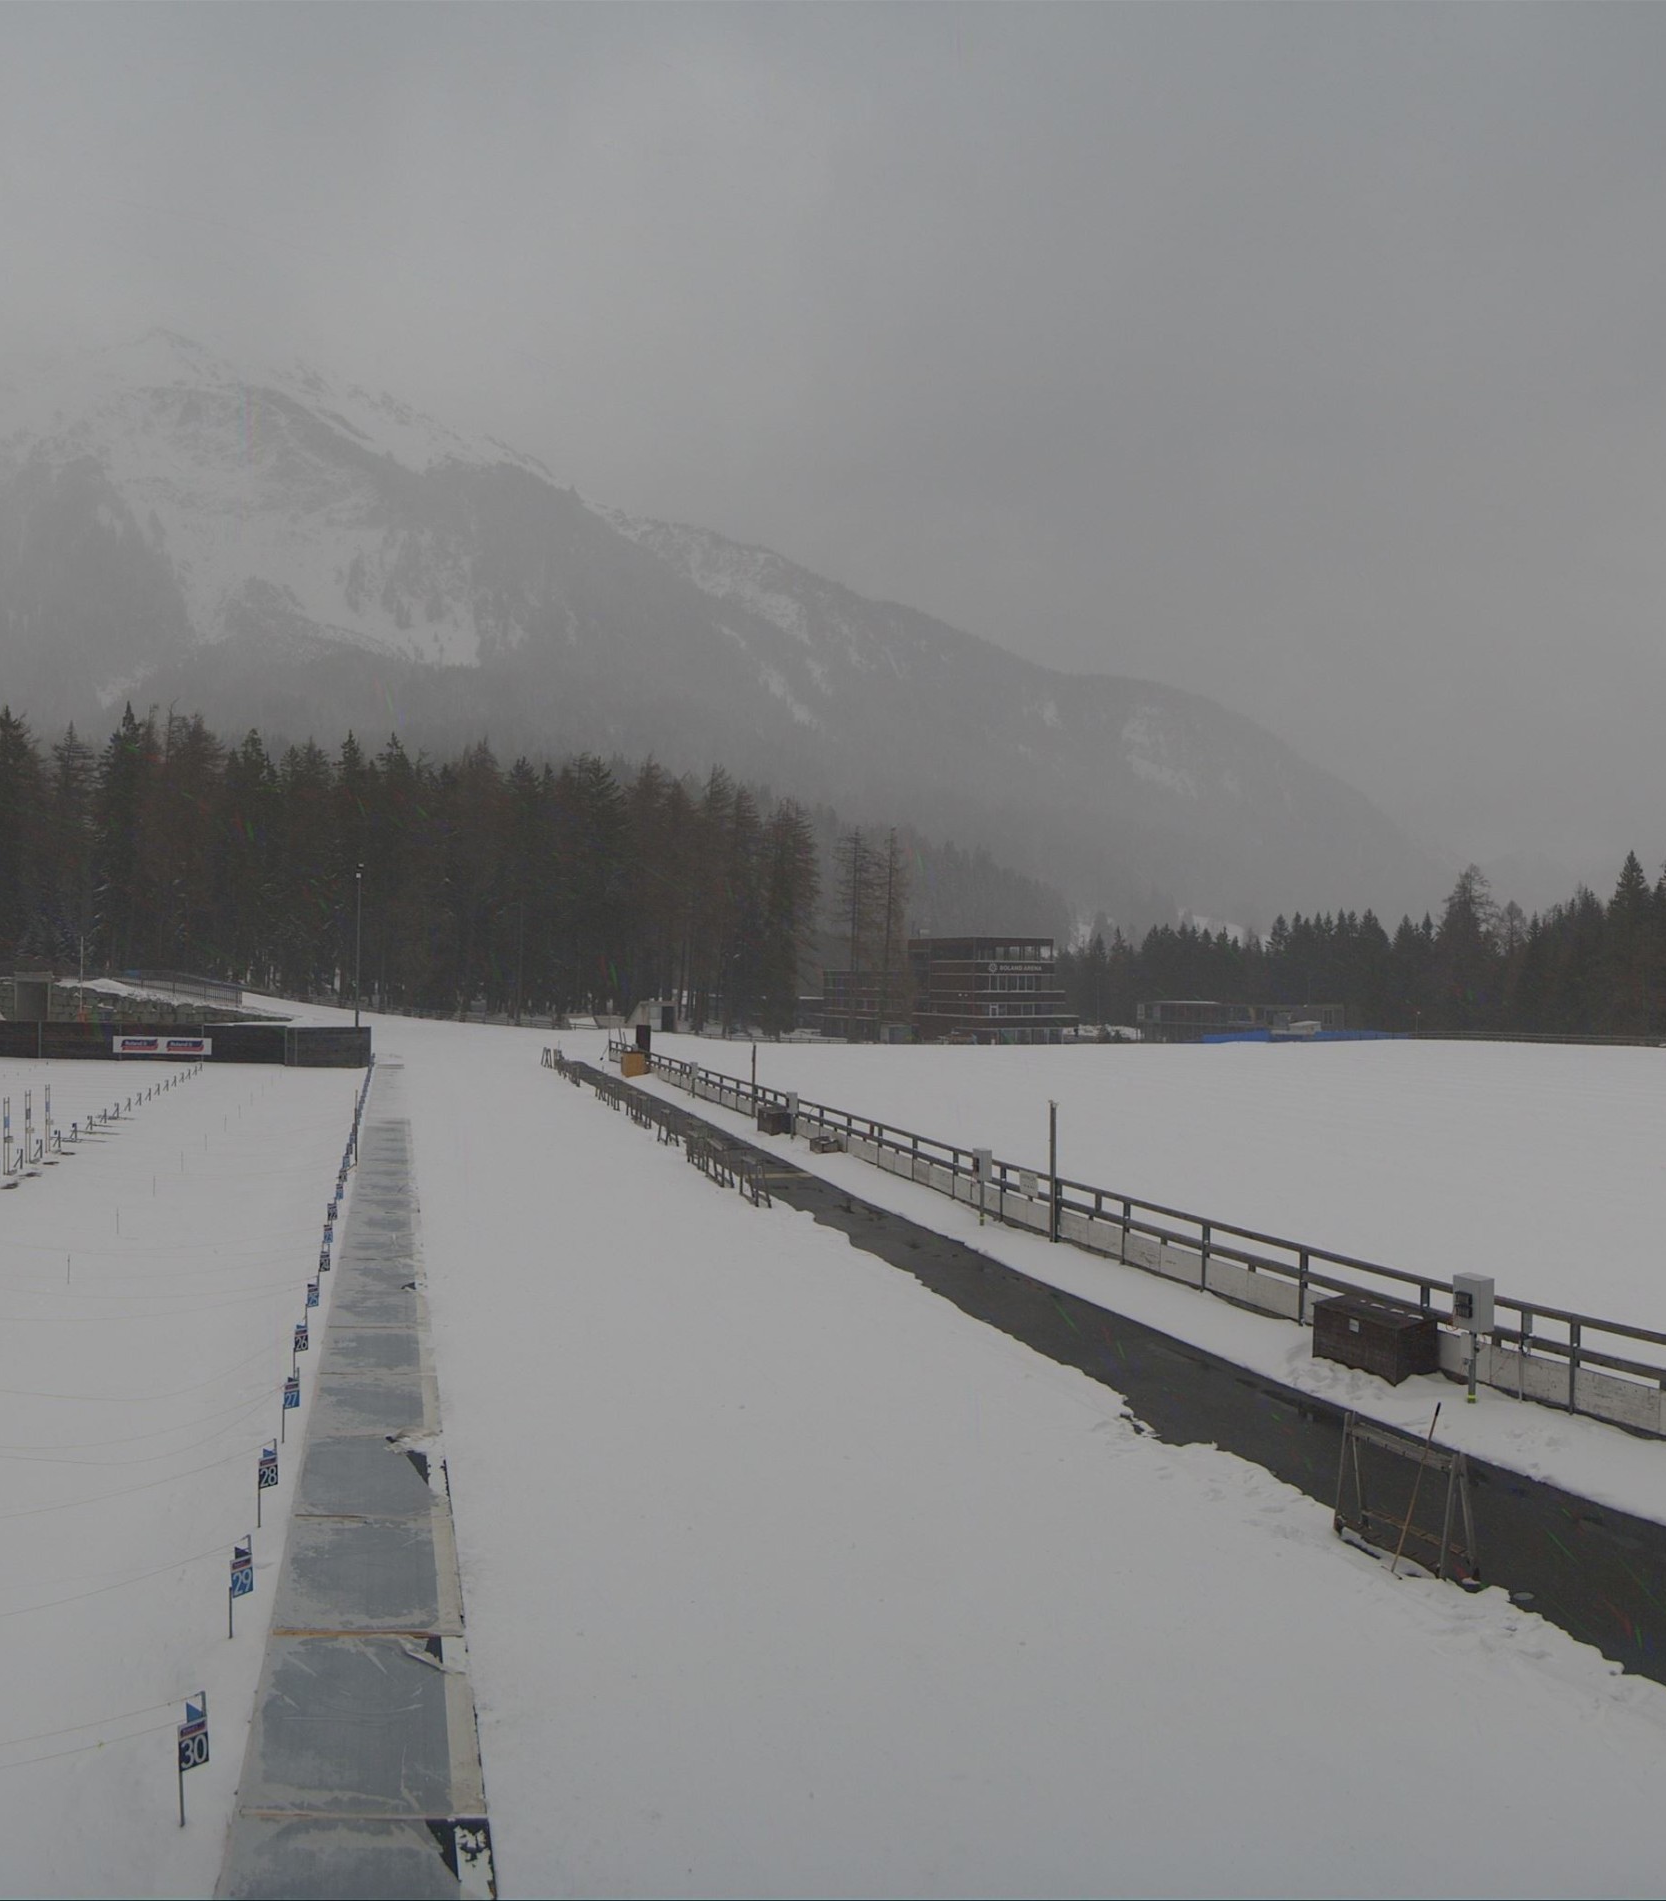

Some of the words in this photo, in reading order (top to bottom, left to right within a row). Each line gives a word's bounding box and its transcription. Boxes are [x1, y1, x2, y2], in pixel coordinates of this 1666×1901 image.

[320, 1259, 330, 1271] 24
[308, 1293, 319, 1307] 25
[295, 1337, 308, 1351] 26
[284, 1392, 298, 1408] 27
[259, 1467, 277, 1488] 28
[232, 1568, 252, 1596] 29
[181, 1734, 207, 1769] 30
